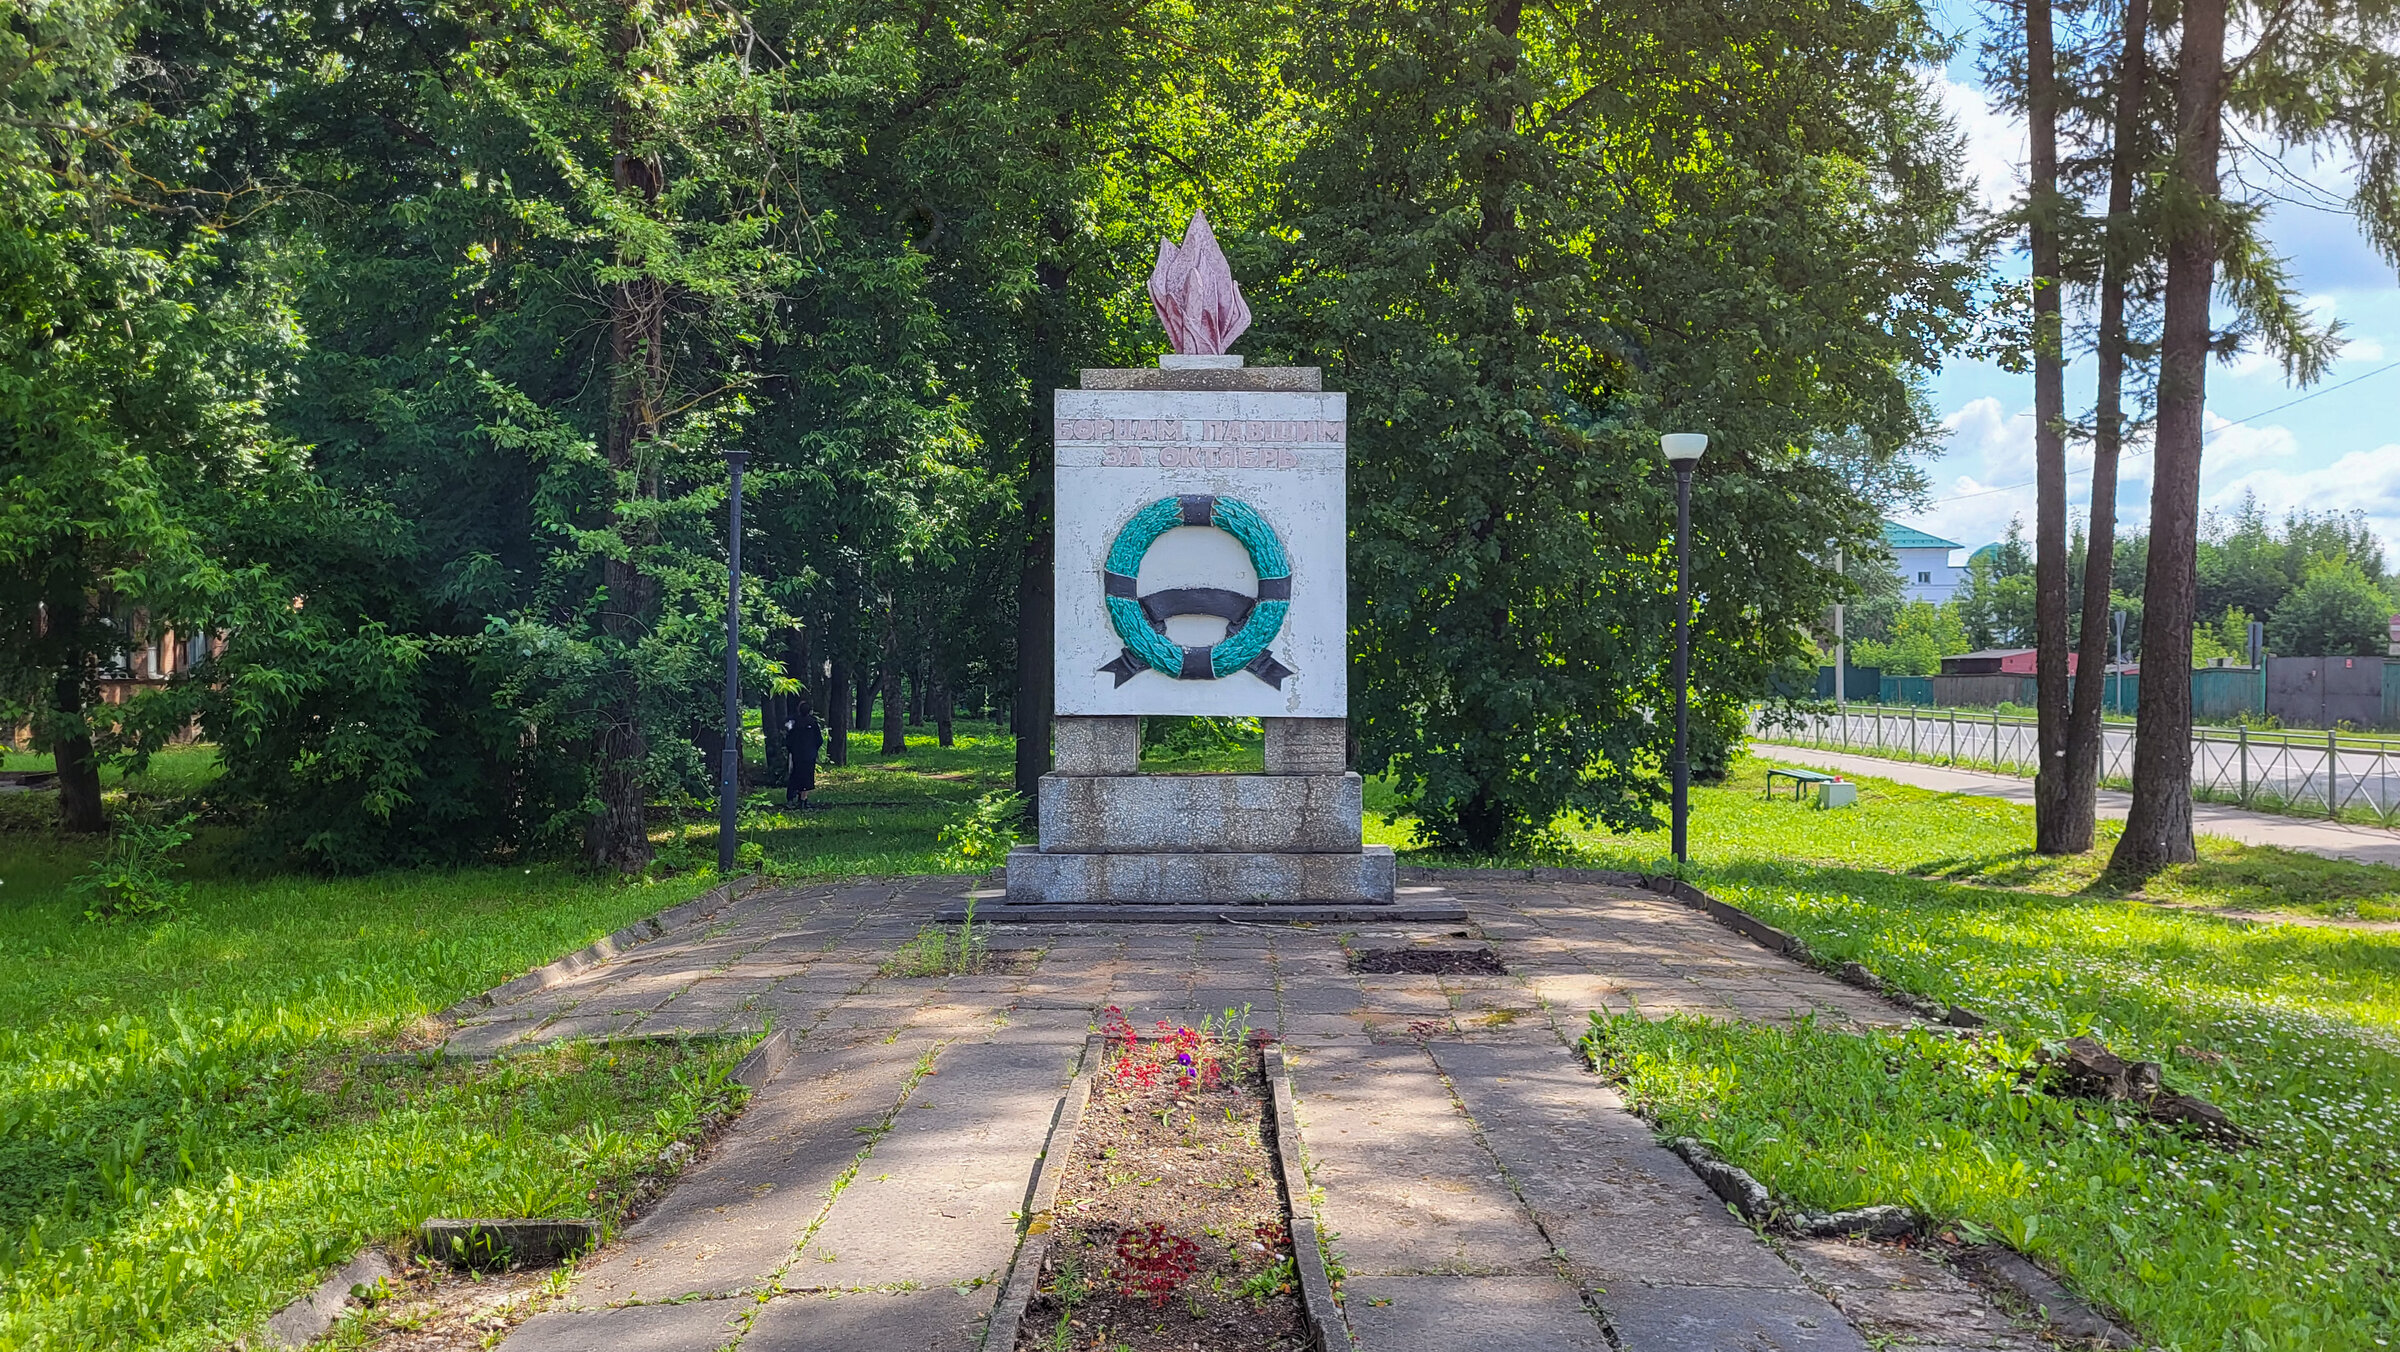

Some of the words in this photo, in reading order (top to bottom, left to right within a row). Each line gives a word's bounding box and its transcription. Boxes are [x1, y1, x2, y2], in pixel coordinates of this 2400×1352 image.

[1203, 420, 1345, 442] ПАВШИМ
[1101, 446, 1144, 467] ЗА
[1158, 447, 1298, 468] ОКТЯБРЬ
